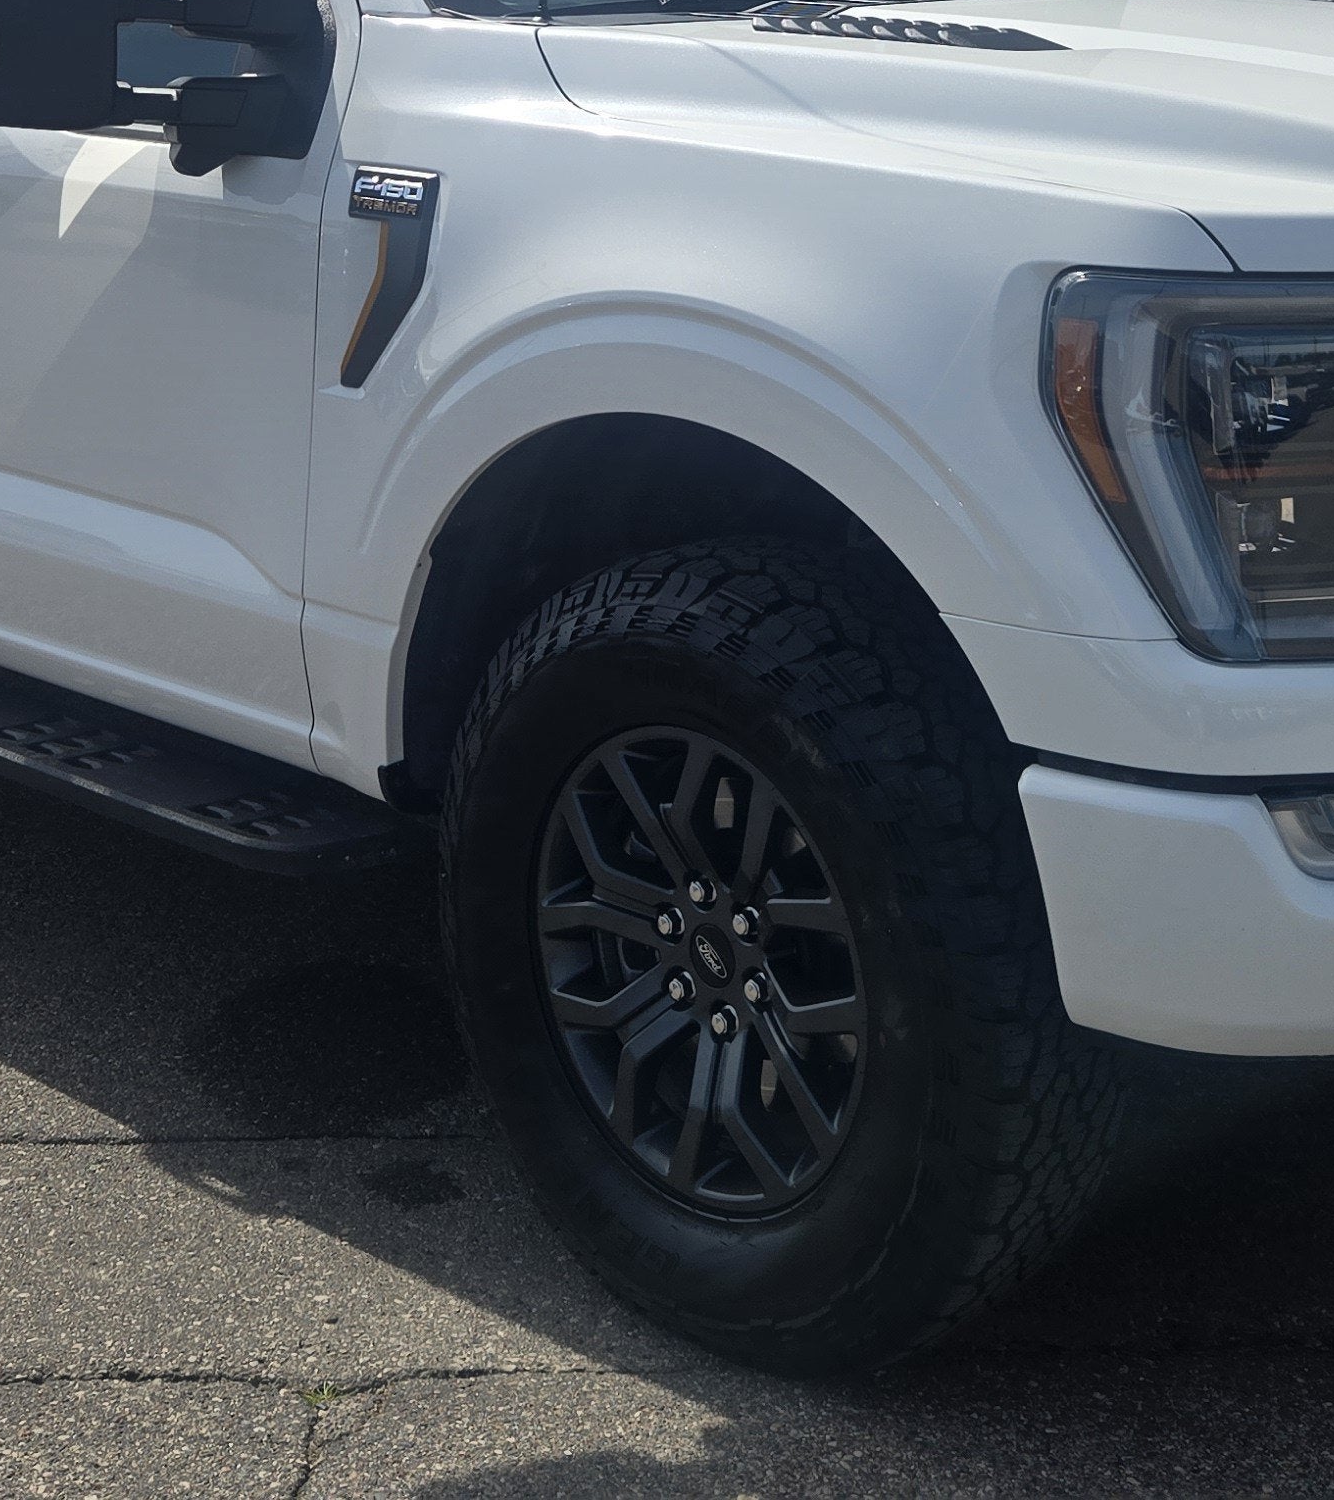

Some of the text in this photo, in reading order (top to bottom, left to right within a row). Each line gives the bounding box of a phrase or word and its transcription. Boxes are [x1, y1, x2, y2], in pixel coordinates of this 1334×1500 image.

[354, 175, 424, 201] F-150
[352, 194, 418, 216] TREMOR
[699, 943, 722, 973] Ford
